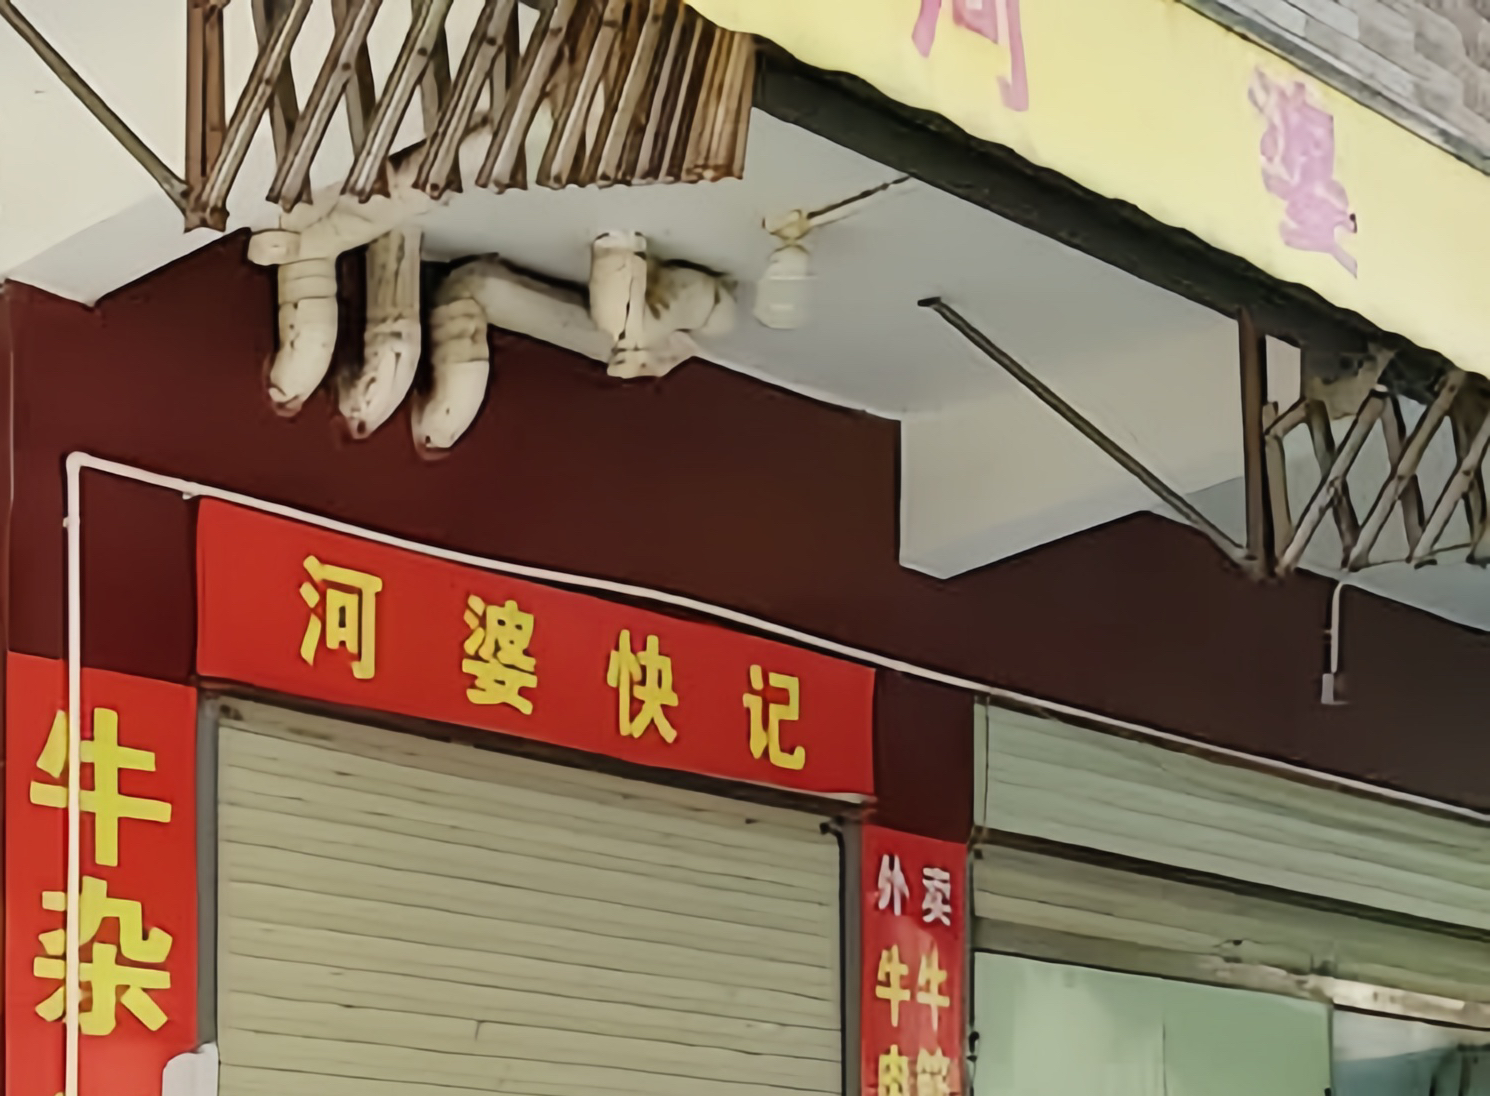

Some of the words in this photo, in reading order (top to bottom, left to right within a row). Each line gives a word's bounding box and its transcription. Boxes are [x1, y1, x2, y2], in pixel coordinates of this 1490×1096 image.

[298, 554, 806, 770] 河婆快记
[876, 853, 952, 926] 外卖
